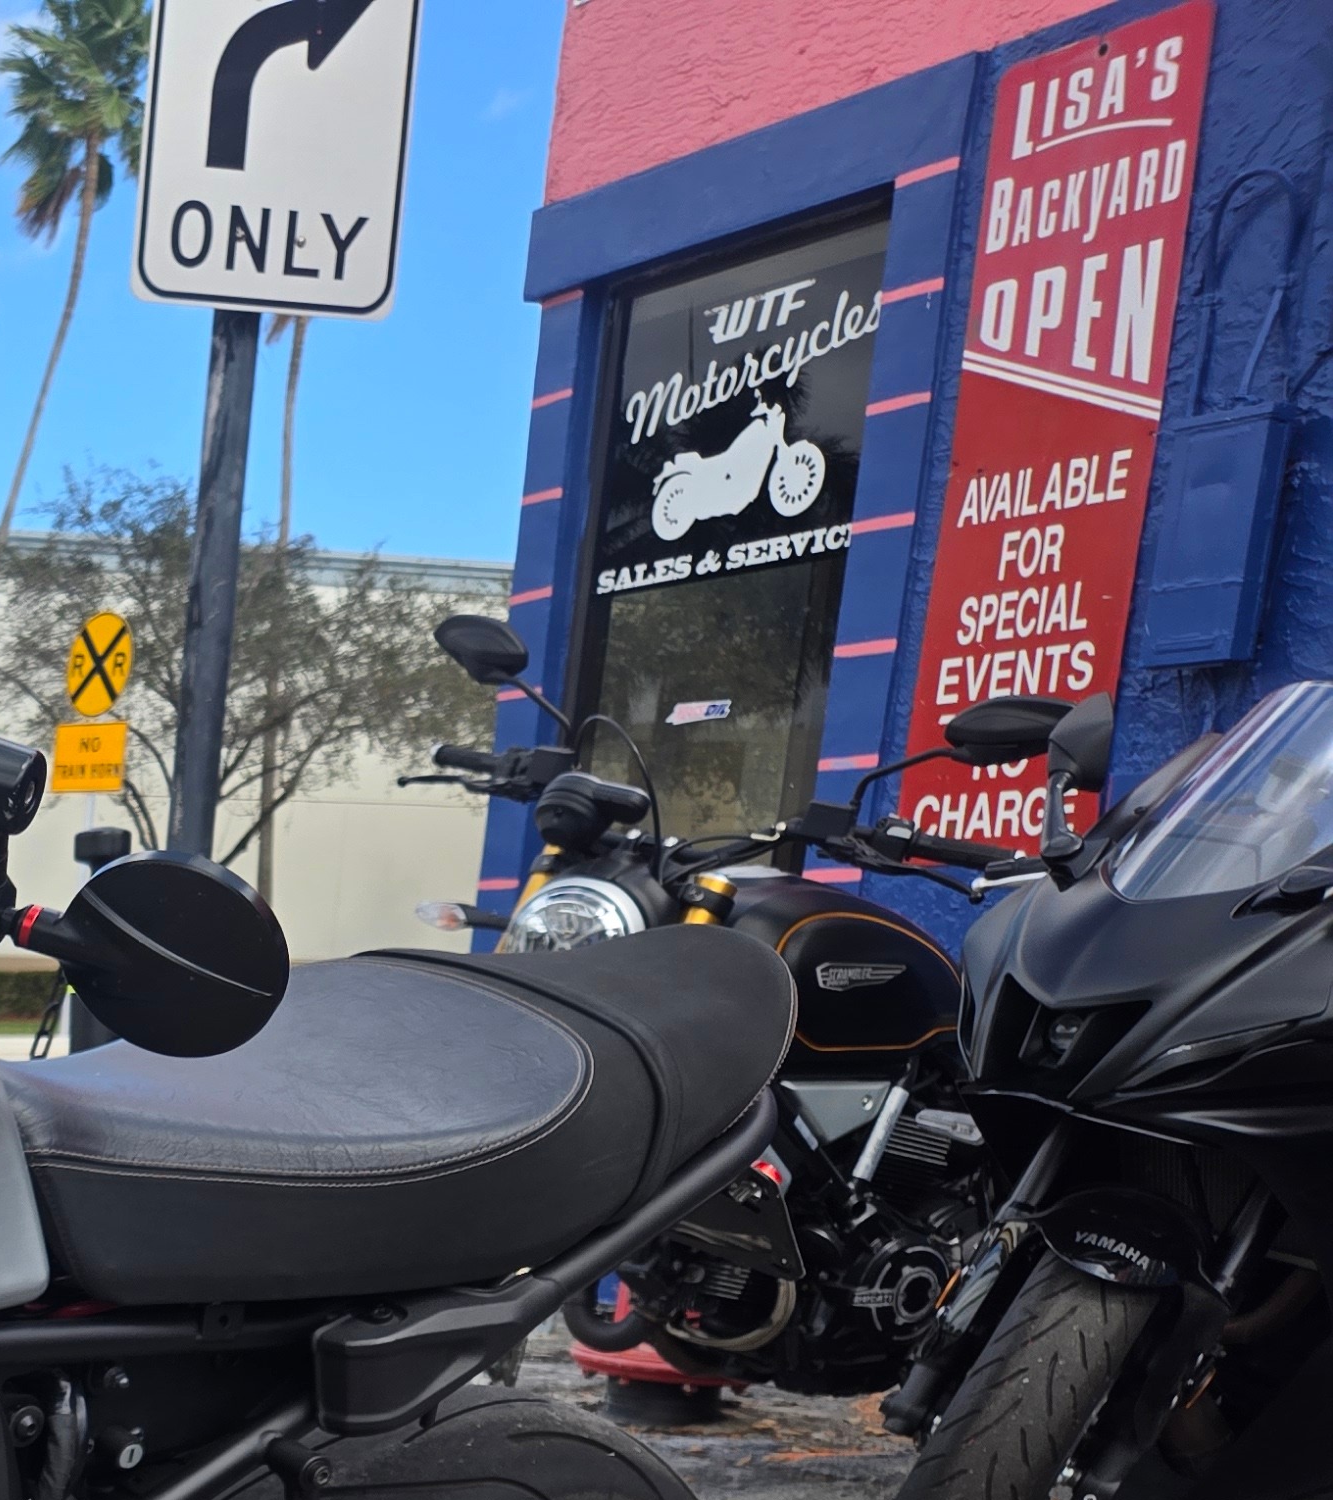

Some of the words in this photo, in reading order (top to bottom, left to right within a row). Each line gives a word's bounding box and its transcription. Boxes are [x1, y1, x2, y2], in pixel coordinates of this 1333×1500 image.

[1011, 36, 1183, 160] LISA'S
[171, 199, 370, 281] ONLY
[980, 238, 1165, 384] OPEN
[957, 449, 1133, 528] AVAILABLE
[596, 554, 693, 595] SALES
[695, 549, 722, 576] &
[998, 524, 1065, 581] FOR
[956, 581, 1088, 646] SPECIAL
[936, 641, 1096, 706] EVENTS
[79, 737, 102, 753] NO
[1075, 1231, 1150, 1271] YAMAHA
